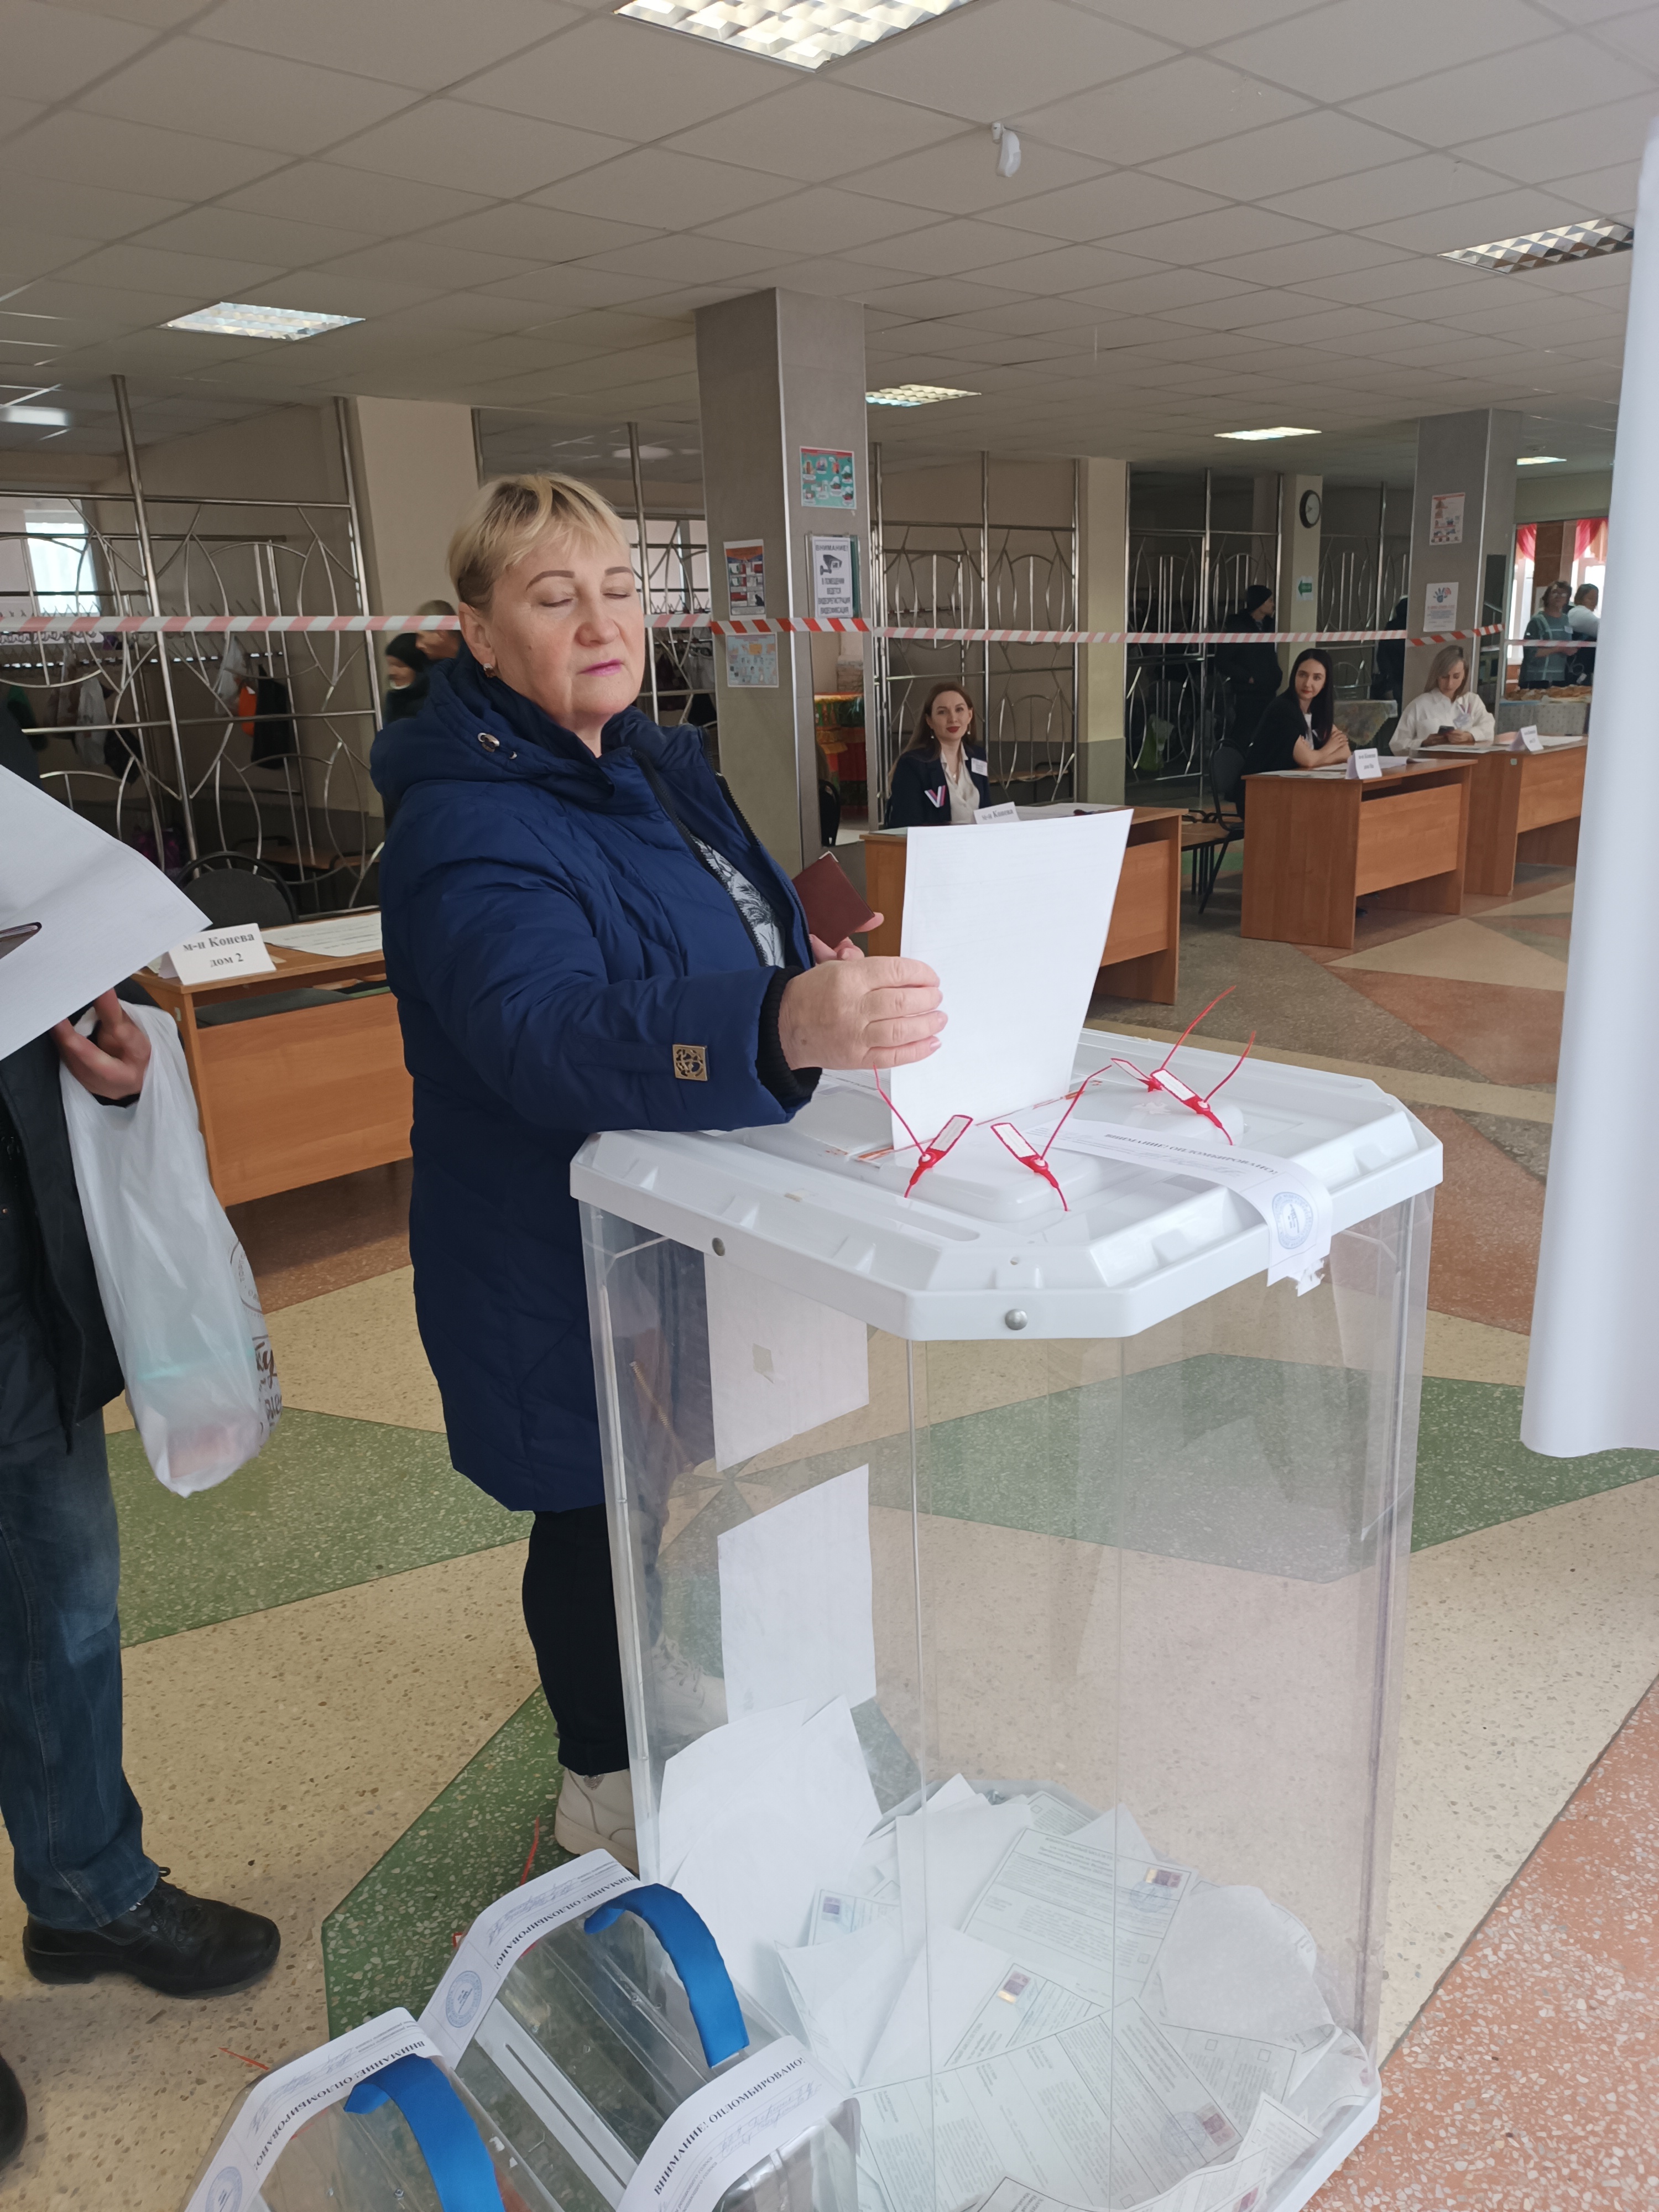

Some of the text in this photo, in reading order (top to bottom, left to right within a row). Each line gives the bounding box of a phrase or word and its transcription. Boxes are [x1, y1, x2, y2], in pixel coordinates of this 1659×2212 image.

[183, 933, 254, 951] м-н Конева
[210, 953, 243, 968] дом 2
[494, 1900, 581, 1969] ОПЛОМБИРОВАНО!
[354, 2041, 425, 2079] ВНИМАНИЕ!
[254, 2077, 353, 2171] ОПЛОМБИРОВАНО!
[654, 2121, 710, 2195] ВНИМАНИЕ!
[709, 2057, 806, 2123] ОПЛОМБИРОВАНО!
